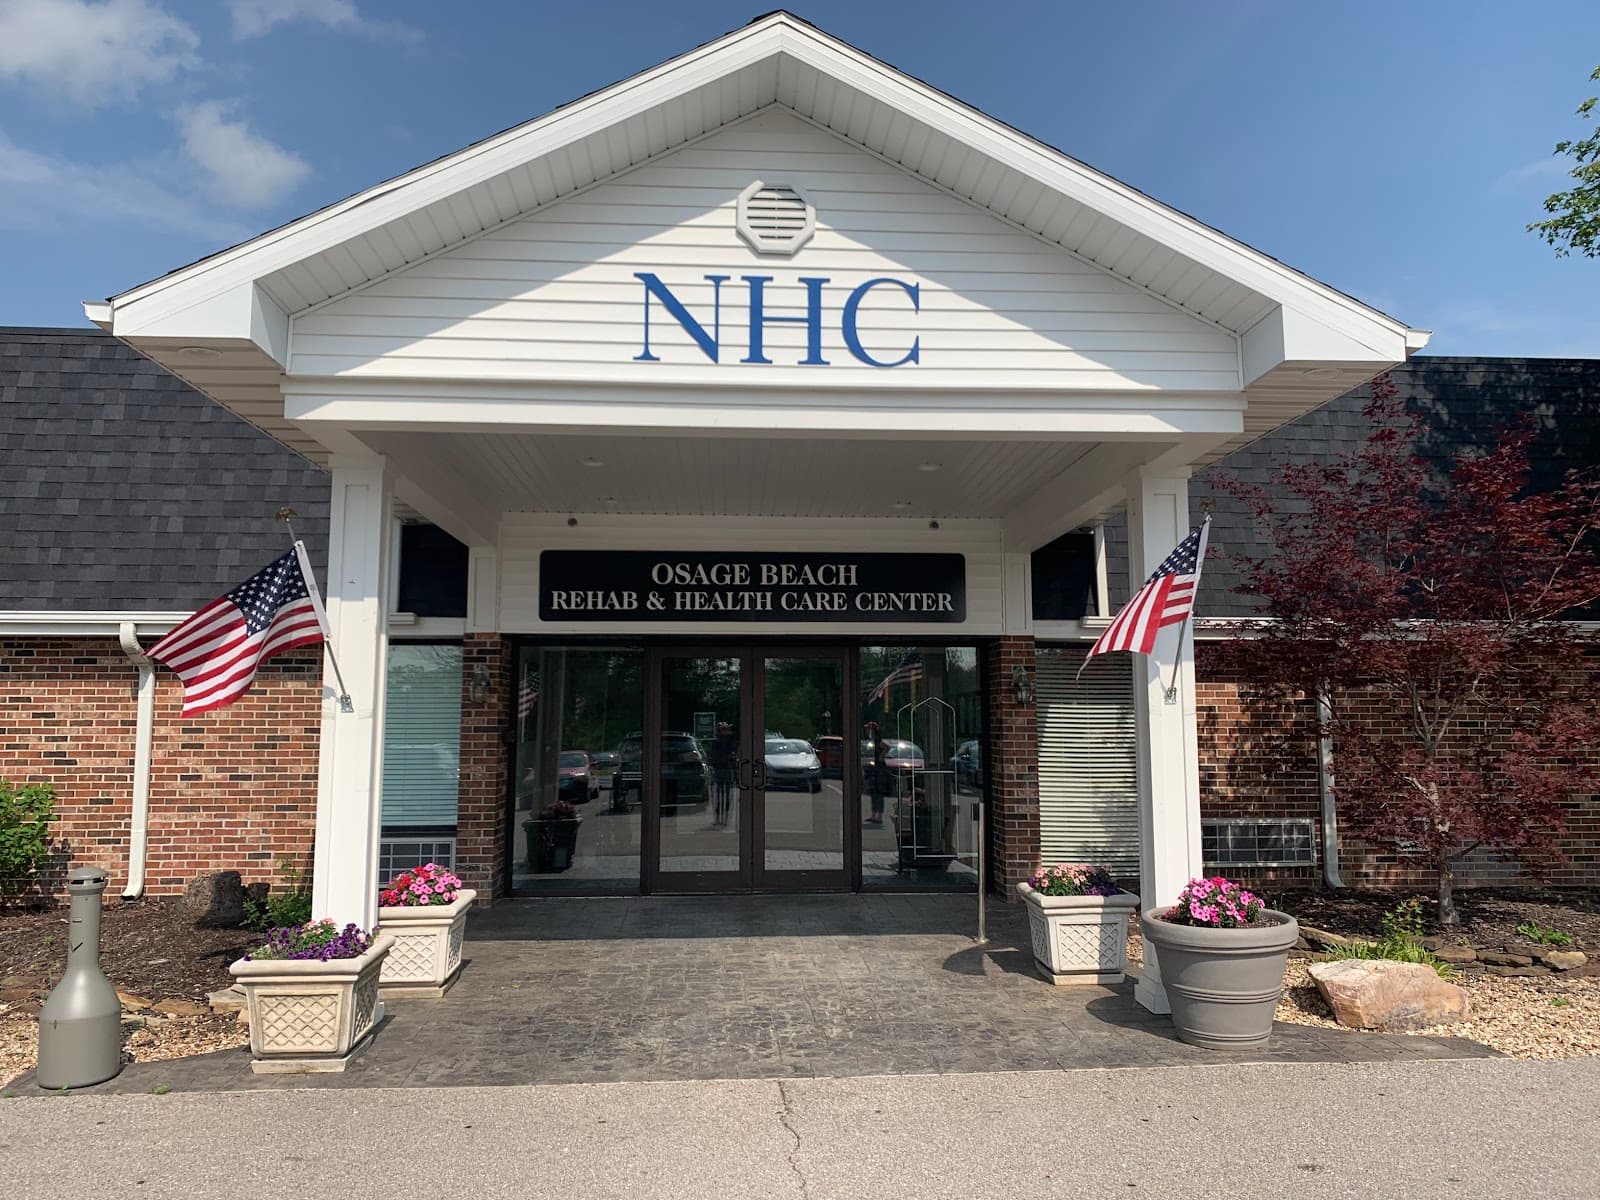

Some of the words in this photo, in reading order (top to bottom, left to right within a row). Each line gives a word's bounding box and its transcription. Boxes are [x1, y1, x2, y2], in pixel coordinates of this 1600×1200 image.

[633, 272, 920, 367] NHC
[651, 563, 751, 586] OSAGE
[760, 564, 858, 587] BEACH
[551, 591, 638, 611] REHAB
[646, 591, 666, 611] &
[674, 591, 773, 611] HEALTH
[781, 591, 848, 612] CARE
[855, 592, 955, 613] CENTER
